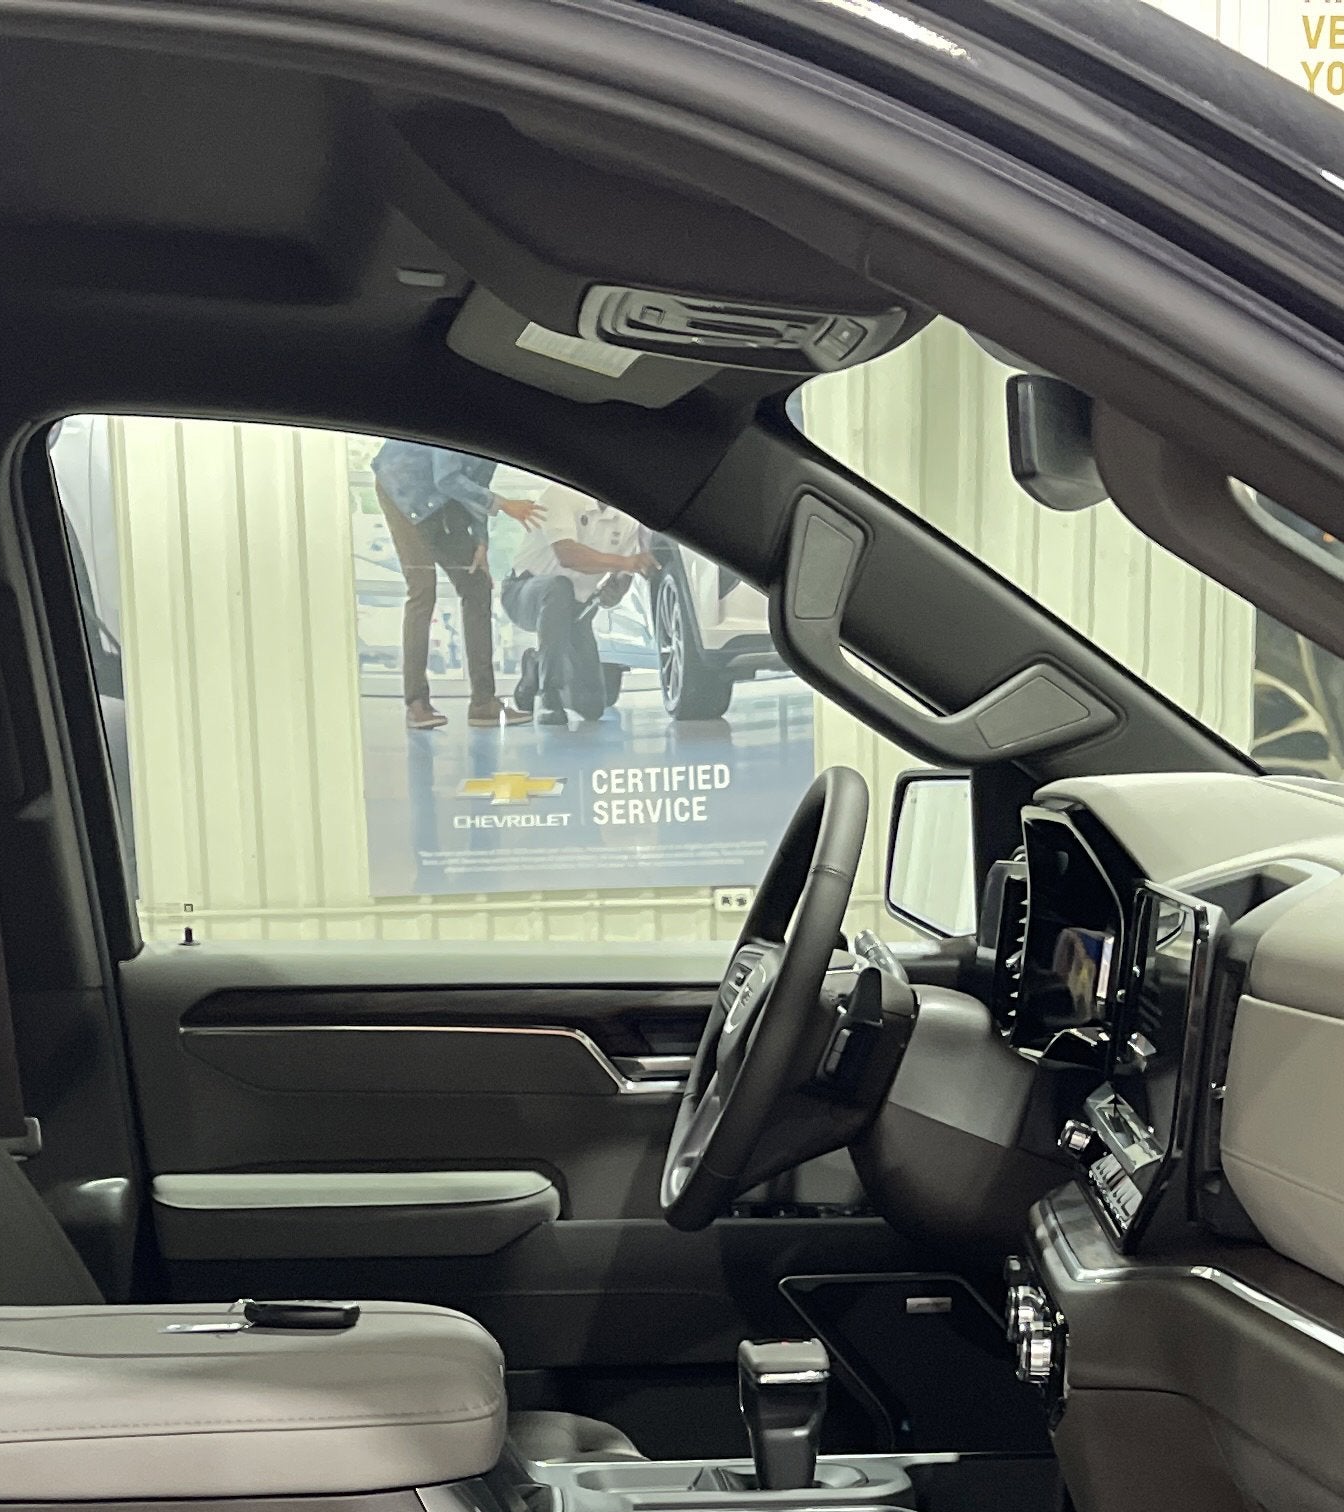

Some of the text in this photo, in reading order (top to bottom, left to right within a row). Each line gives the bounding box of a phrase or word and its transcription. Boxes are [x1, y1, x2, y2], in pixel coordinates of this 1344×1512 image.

[591, 764, 731, 795] CERTIFIED
[453, 813, 571, 829] CHEVROLET
[592, 796, 708, 825] SERVICE
